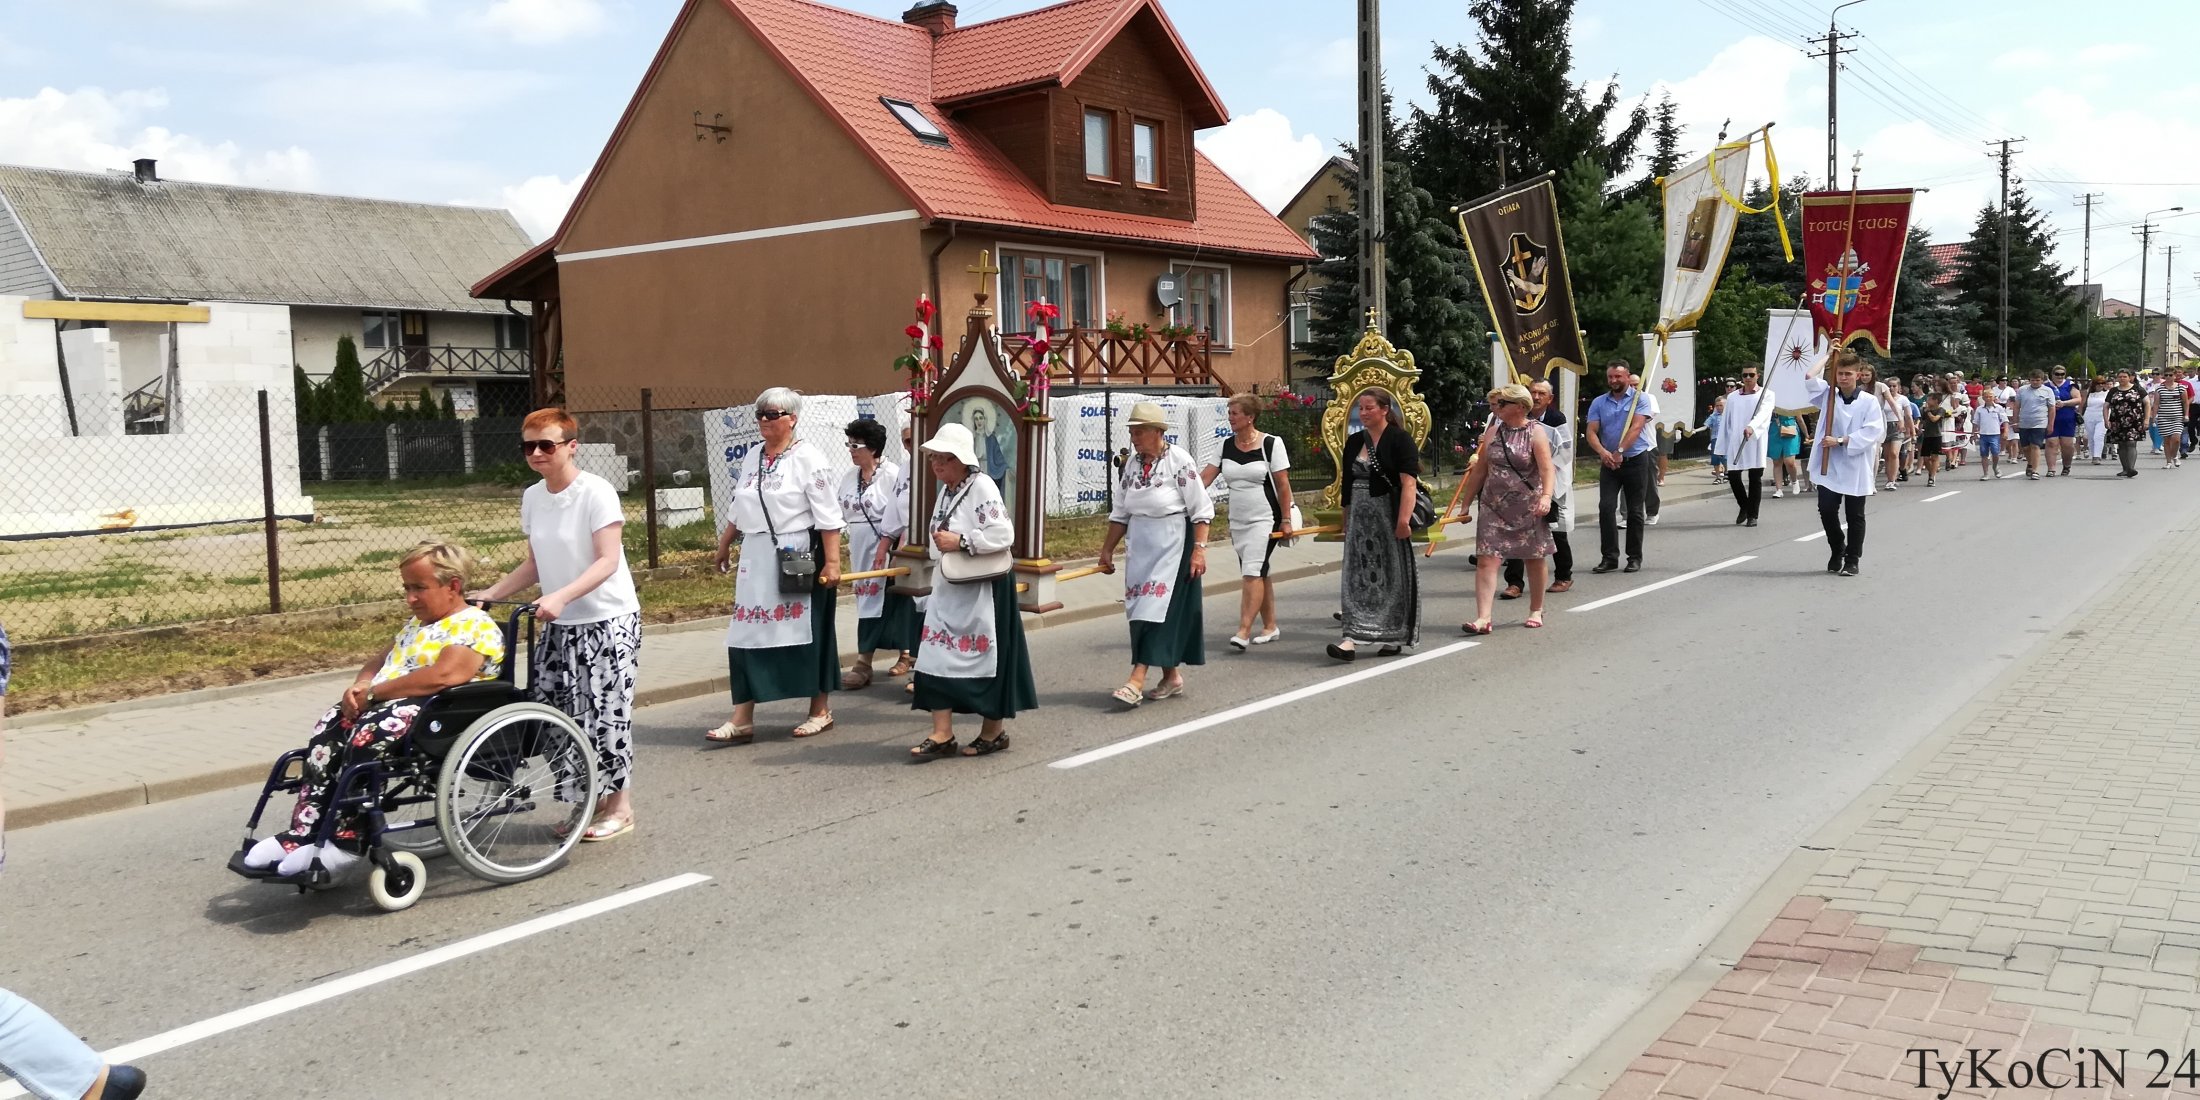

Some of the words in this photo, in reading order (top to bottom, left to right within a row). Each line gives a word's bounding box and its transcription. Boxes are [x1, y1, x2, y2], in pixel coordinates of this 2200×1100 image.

[1808, 220, 1850, 232] TOTUS
[1857, 217, 1898, 230] TUUS
[1076, 490, 1108, 503] SOLBE
